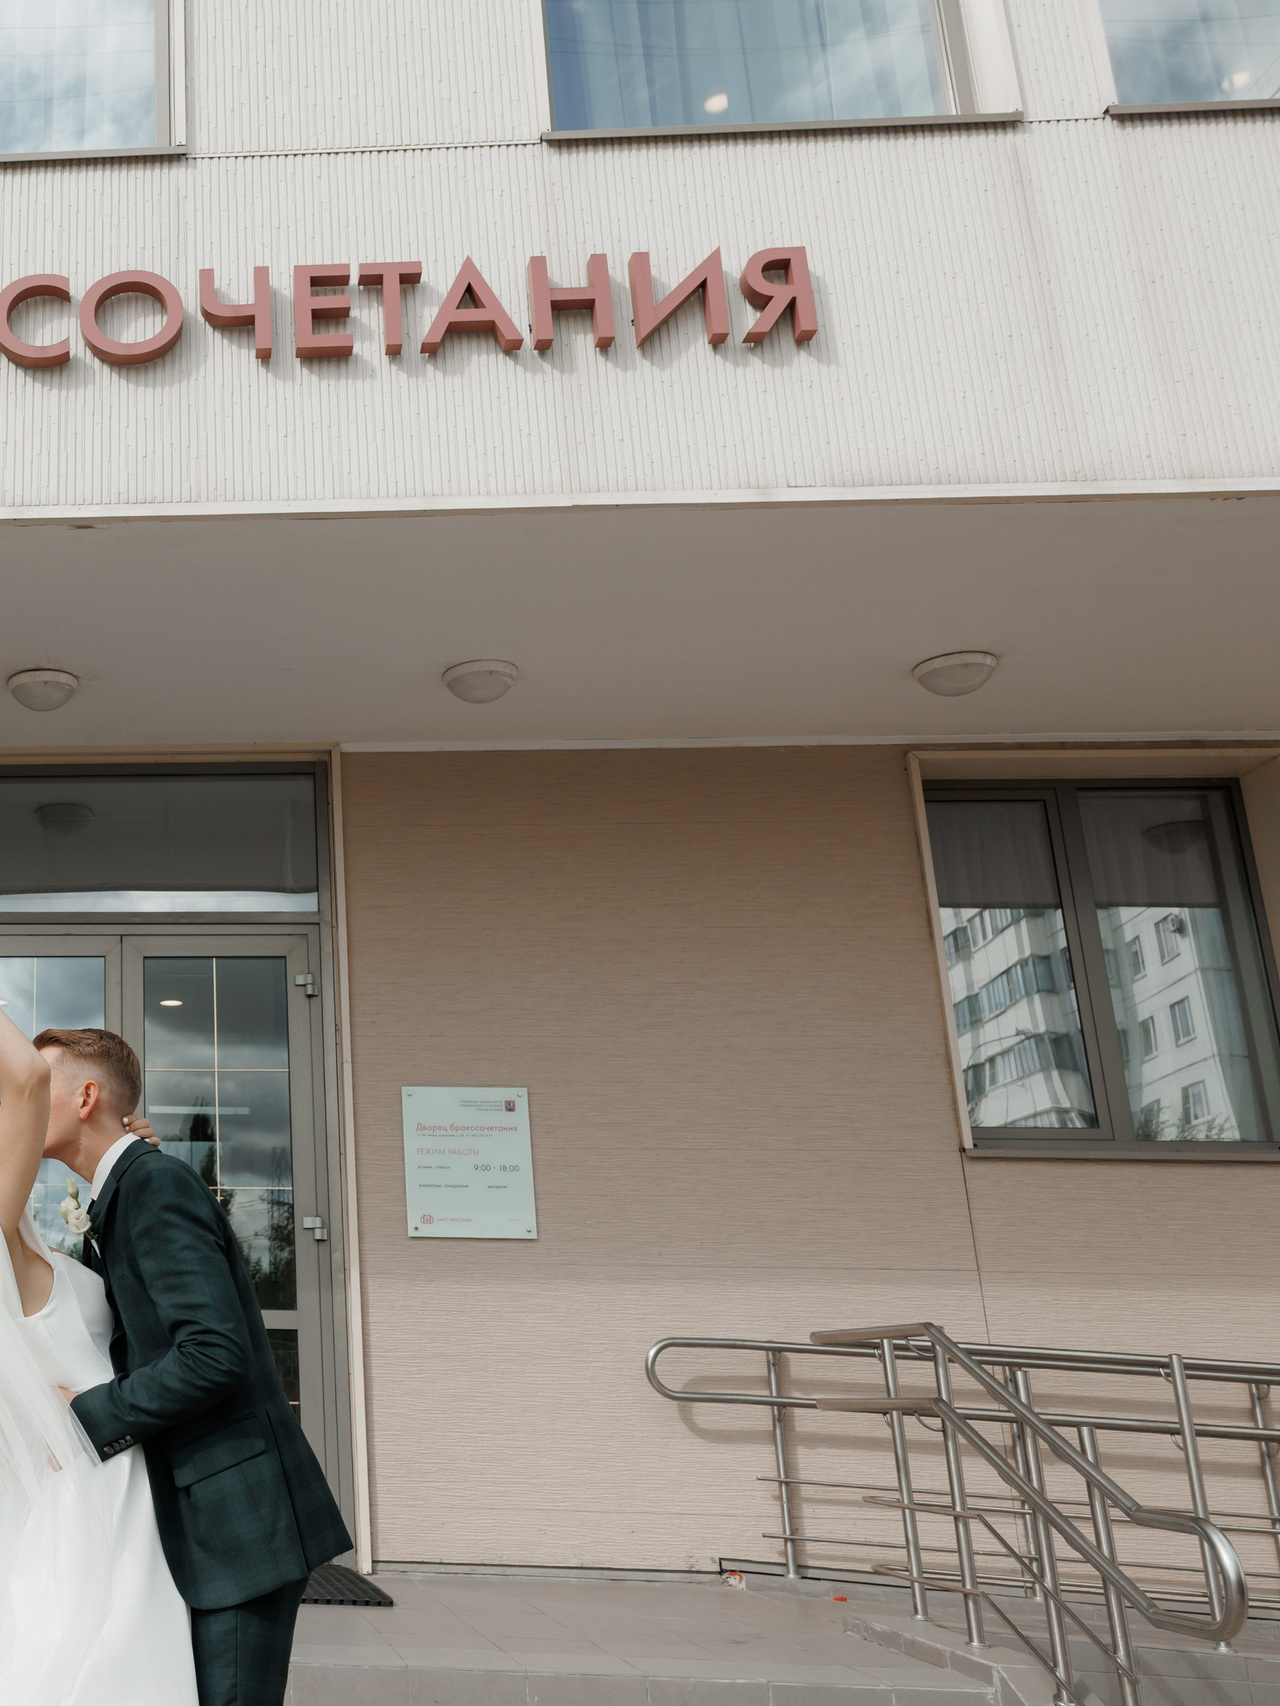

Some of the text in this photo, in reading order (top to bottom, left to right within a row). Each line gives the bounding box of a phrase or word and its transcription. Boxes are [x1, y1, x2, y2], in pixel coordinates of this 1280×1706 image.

[416, 1123, 518, 1133] Дворец бракосочетания
[416, 1148, 446, 1156] РЕЖИМ
[473, 1164, 492, 1172] 9:00
[499, 1164, 520, 1172] 18:00
